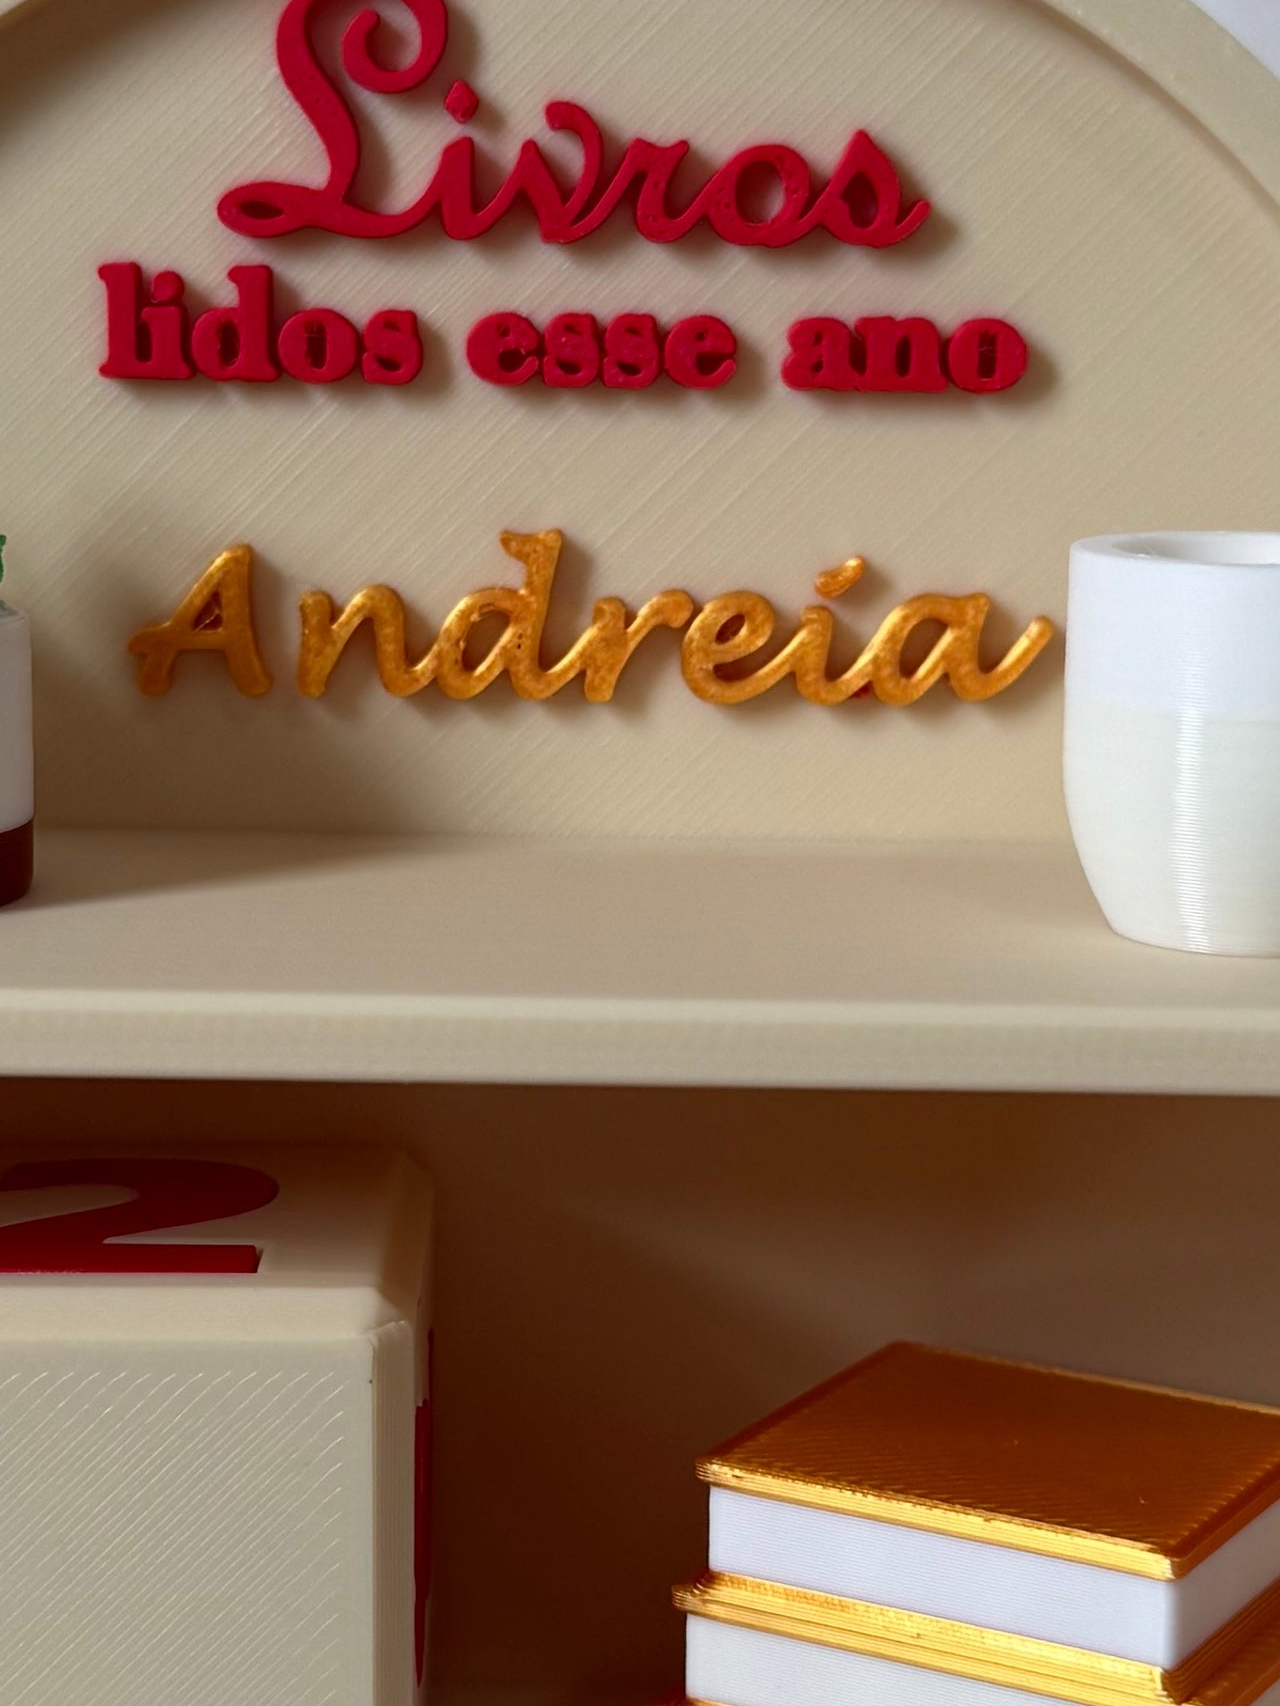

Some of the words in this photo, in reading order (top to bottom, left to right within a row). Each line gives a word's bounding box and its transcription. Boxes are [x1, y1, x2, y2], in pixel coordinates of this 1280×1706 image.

[96, 260, 424, 388] lidos
[465, 310, 740, 393] esse
[780, 314, 1031, 397] ano
